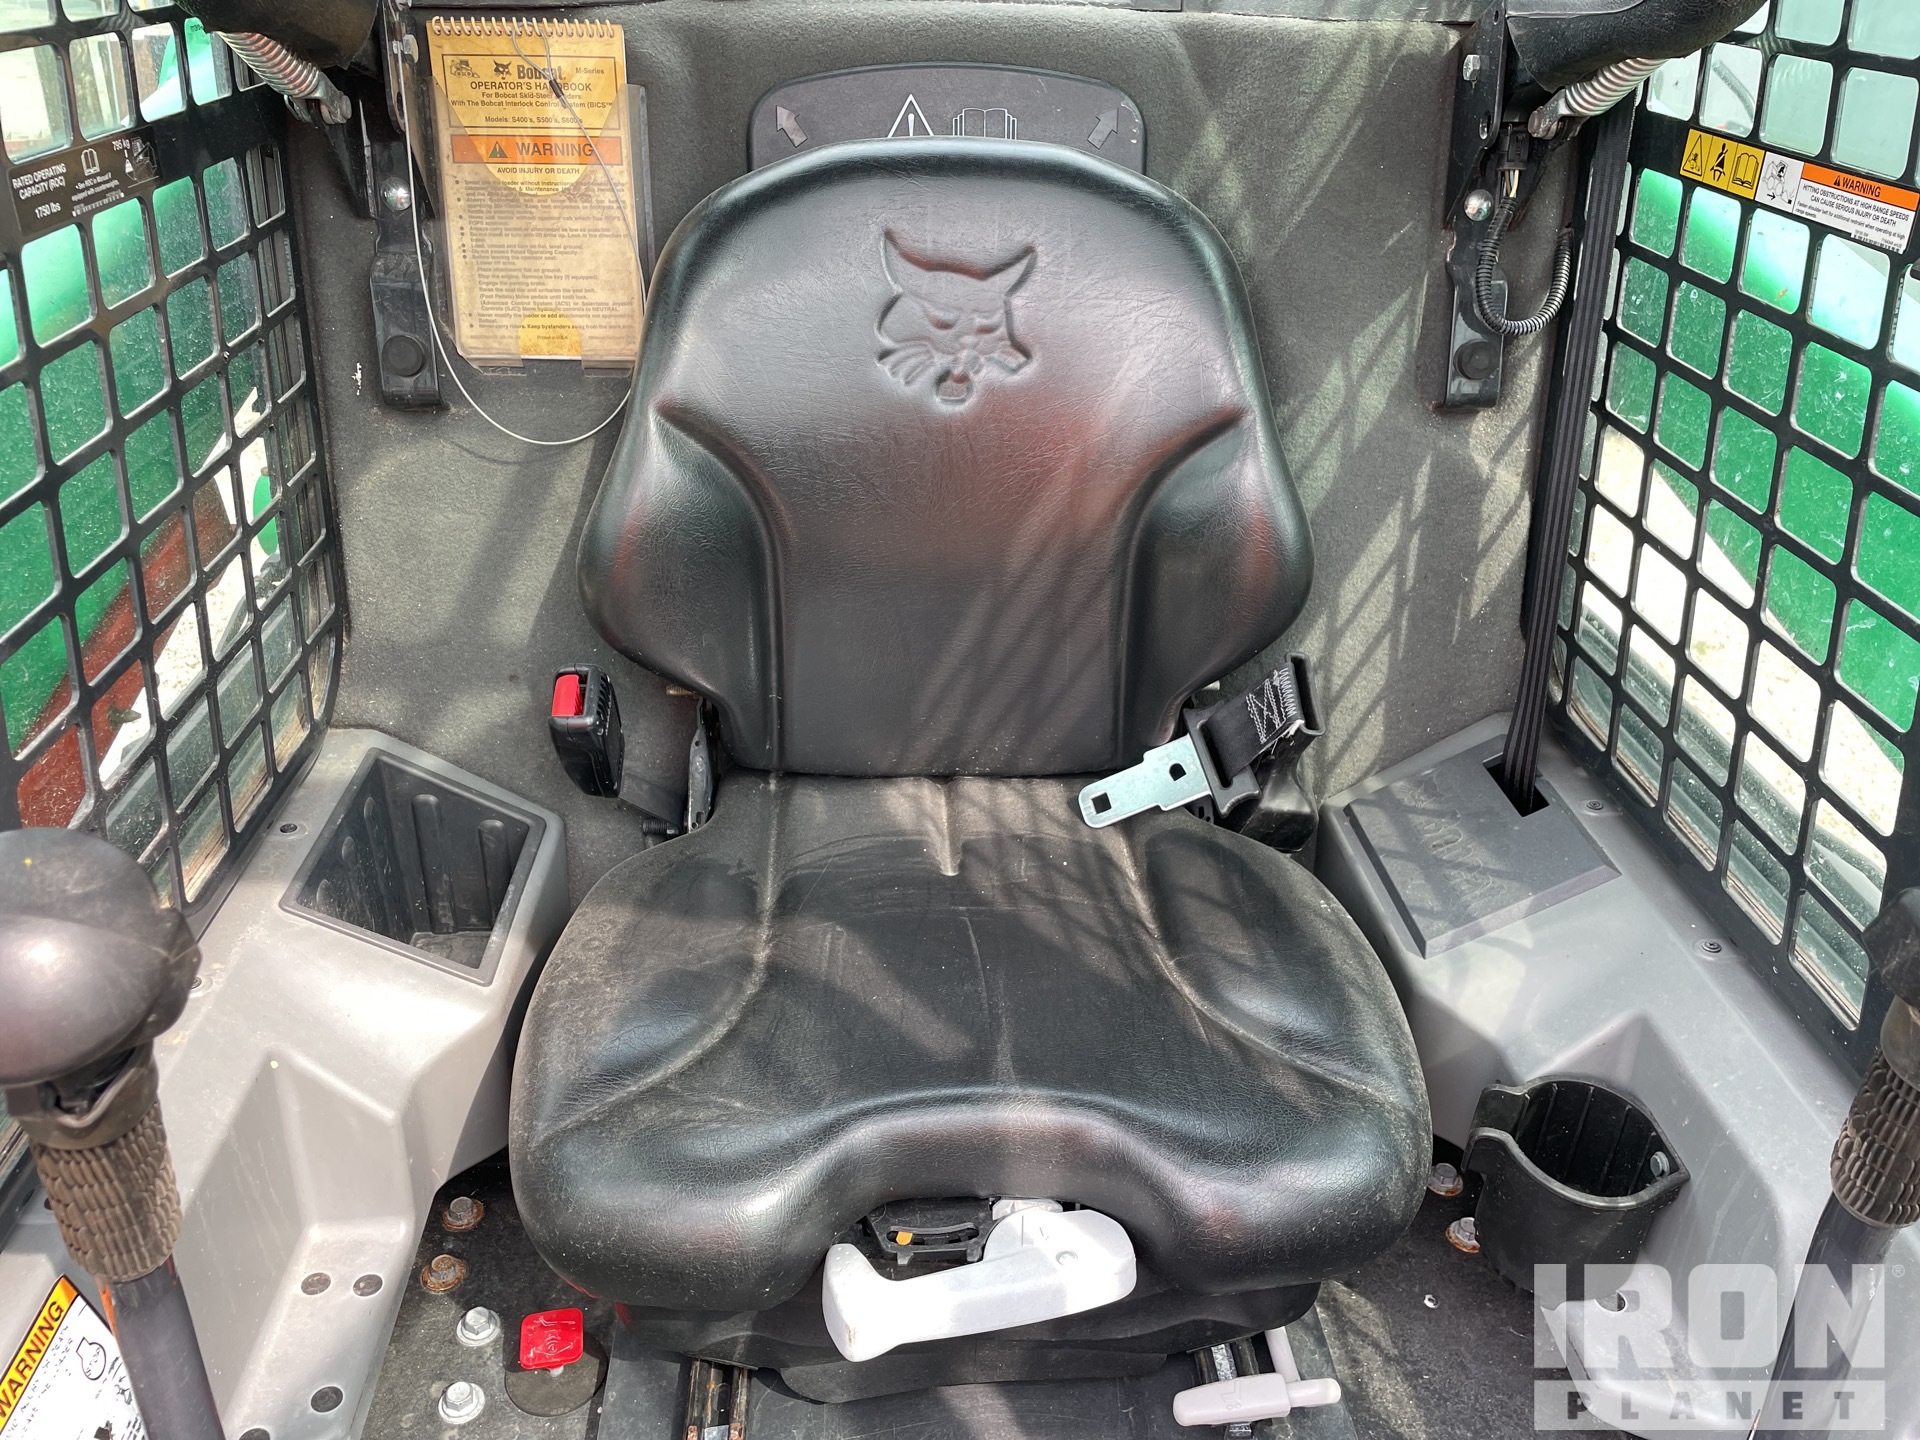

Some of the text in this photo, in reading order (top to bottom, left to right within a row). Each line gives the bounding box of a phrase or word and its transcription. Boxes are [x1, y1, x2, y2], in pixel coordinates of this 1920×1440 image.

[470, 81, 532, 90] OPERATOR'S
[122, 137, 130, 149] kg
[516, 142, 595, 156] WARNING
[12, 163, 66, 188] RATED OPERATING
[19, 176, 66, 200] CAPACITY (ROC)
[1842, 177, 1882, 197] WARNING
[35, 204, 51, 218] 1750
[50, 201, 61, 212] lbs
[1803, 184, 1820, 194] HITTING
[1820, 189, 1854, 204] OBSTRUCTIONS
[1860, 201, 1872, 210] HIGH
[1872, 205, 1889, 215] RANGE
[1889, 210, 1909, 221] SPEEDS
[1821, 198, 1834, 207] CAUSE
[1835, 203, 1854, 213] SERIOUS
[1855, 209, 1872, 219] INJURY
[1880, 217, 1896, 226] DEATH
[0, 1301, 64, 1418] WARNING
